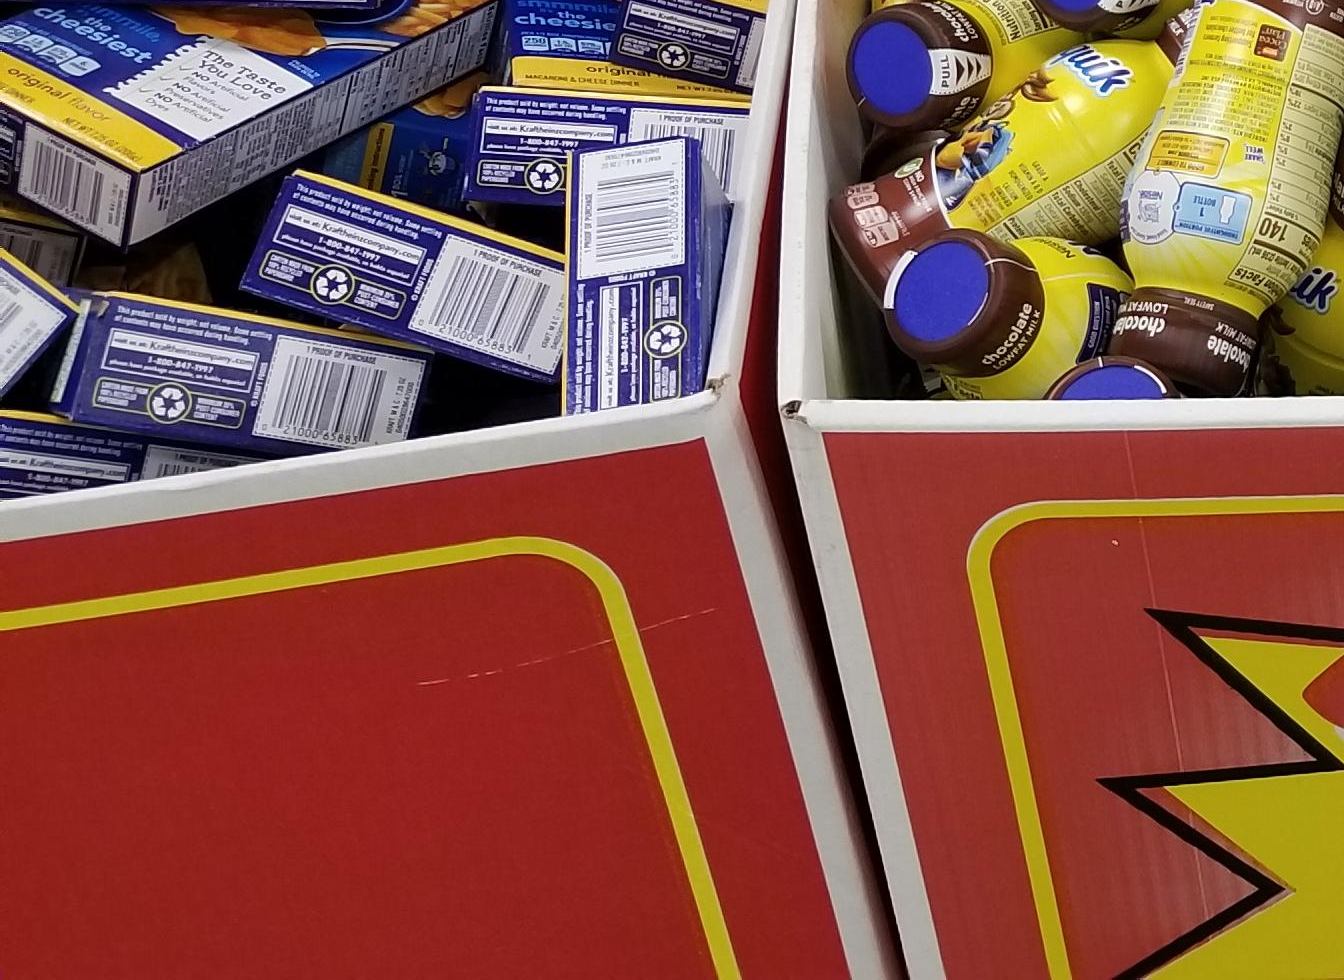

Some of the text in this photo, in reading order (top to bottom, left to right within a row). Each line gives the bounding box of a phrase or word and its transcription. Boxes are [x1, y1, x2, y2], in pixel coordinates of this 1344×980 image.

[85, 16, 112, 33] the
[558, 11, 586, 20] the
[33, 7, 153, 65] cheesiest
[524, 35, 547, 45] 250
[199, 59, 273, 101] You Love
[203, 50, 287, 95] The Taste
[586, 64, 651, 77] original
[941, 54, 950, 89] PULL
[8, 67, 110, 122] original flavor
[173, 81, 231, 113] NO Artificial
[192, 71, 250, 102] NO Artificial
[154, 92, 213, 124] NO Artificial
[164, 86, 224, 121] Preservatives
[663, 114, 724, 126] PROOF PURCHASE
[321, 221, 420, 262] Kraftheinzcompany.com
[1258, 217, 1289, 243] 140
[317, 235, 381, 263] 1-800-847-1997
[981, 302, 1033, 367] chocolate
[1214, 321, 1238, 339] MILK
[312, 346, 332, 357] PROOF
[991, 337, 1026, 371] LOWFAT
[283, 425, 319, 440] 21000
